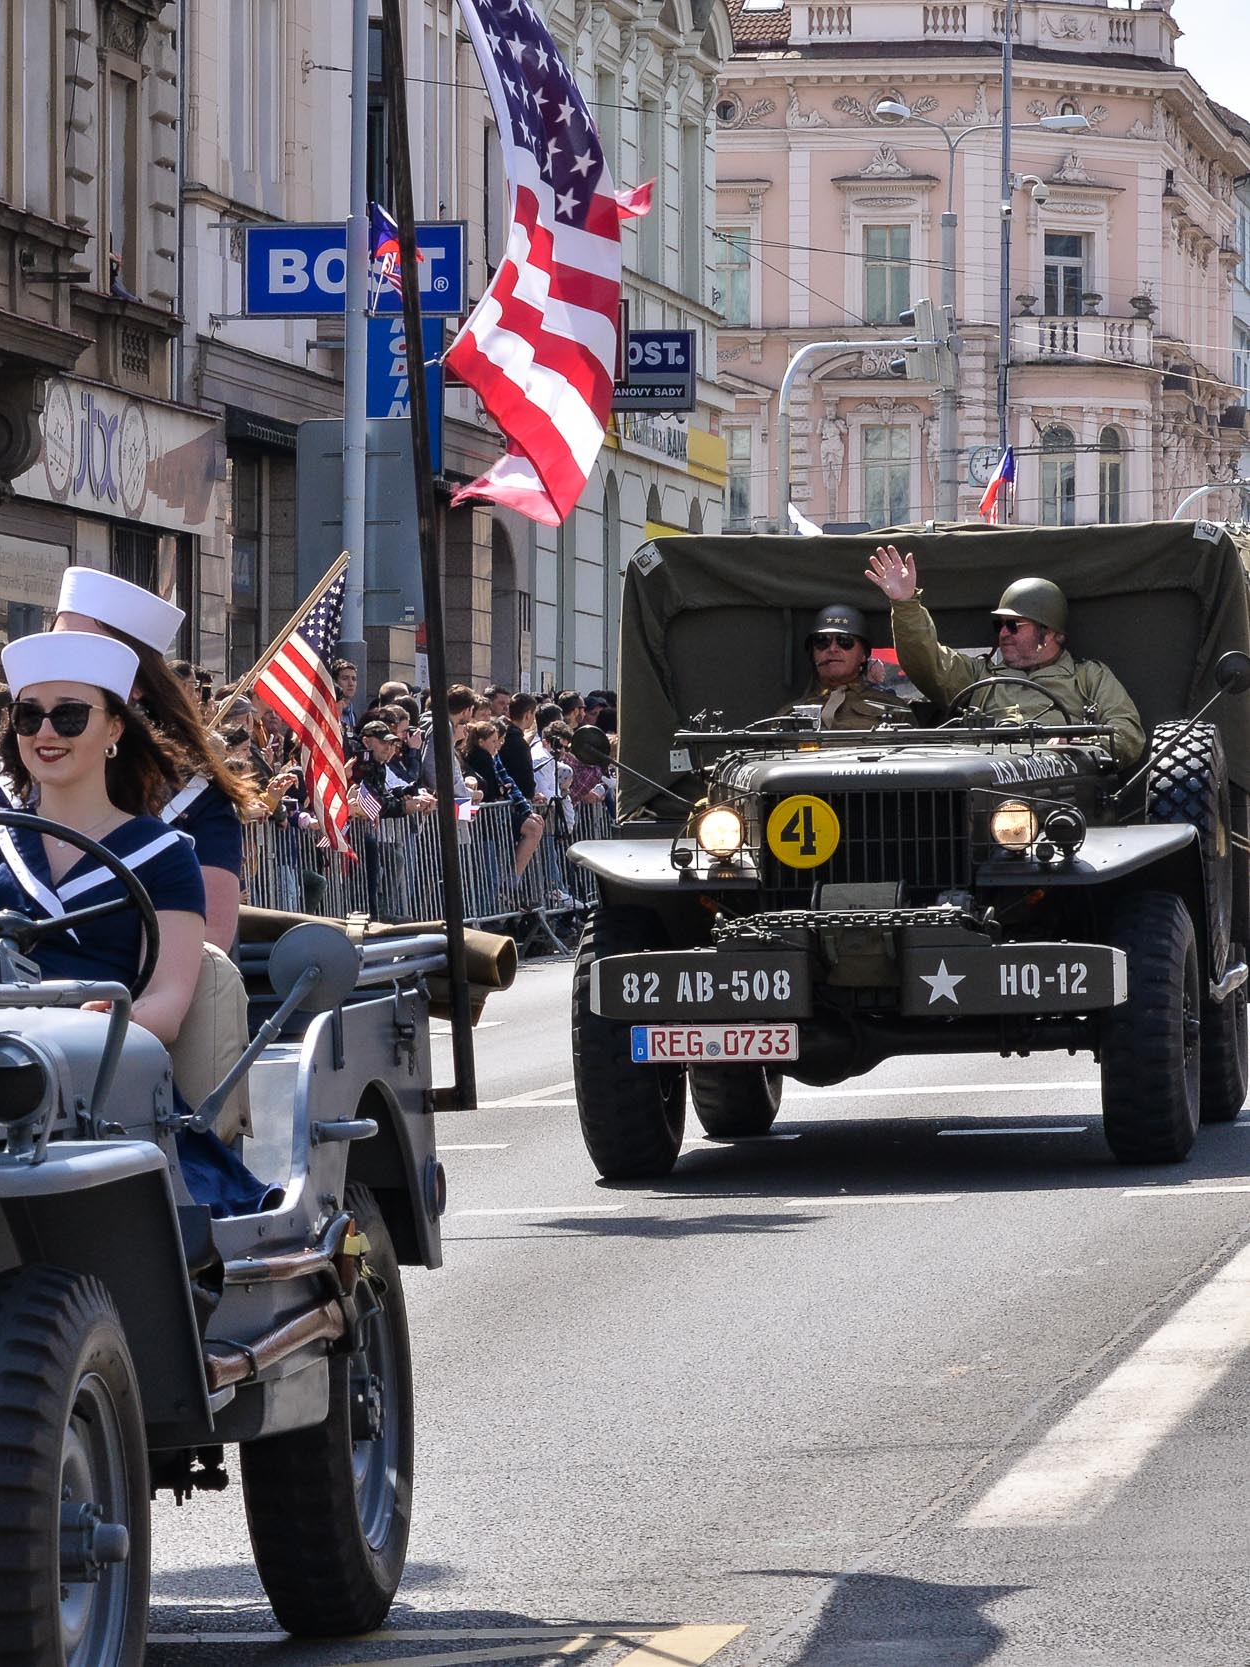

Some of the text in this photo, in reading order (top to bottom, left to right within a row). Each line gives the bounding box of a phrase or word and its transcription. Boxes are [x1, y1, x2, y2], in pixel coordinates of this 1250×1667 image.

[654, 387, 683, 397] SADY
[780, 805, 817, 856] 4
[622, 969, 791, 1004] 82 AB-508
[1000, 962, 1088, 999] HQ-12
[637, 1029, 790, 1057] D REG 0733
